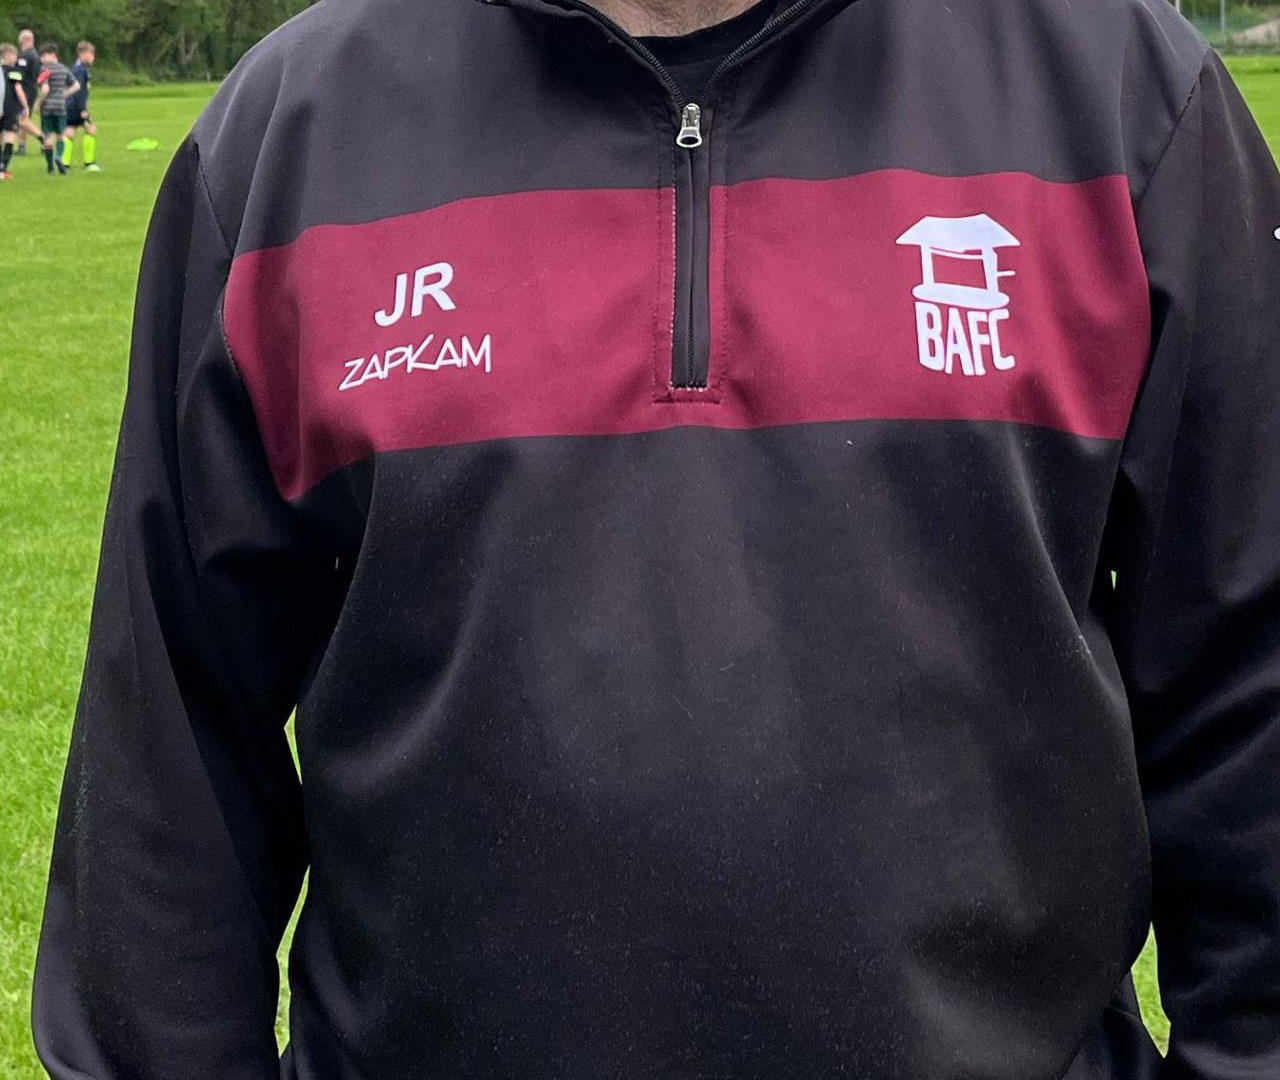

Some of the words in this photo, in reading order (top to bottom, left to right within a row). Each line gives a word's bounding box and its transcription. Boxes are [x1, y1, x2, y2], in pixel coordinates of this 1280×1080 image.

[374, 262, 456, 327] JR
[338, 333, 491, 391] ZAPKAM
[915, 301, 1015, 376] BAFC
